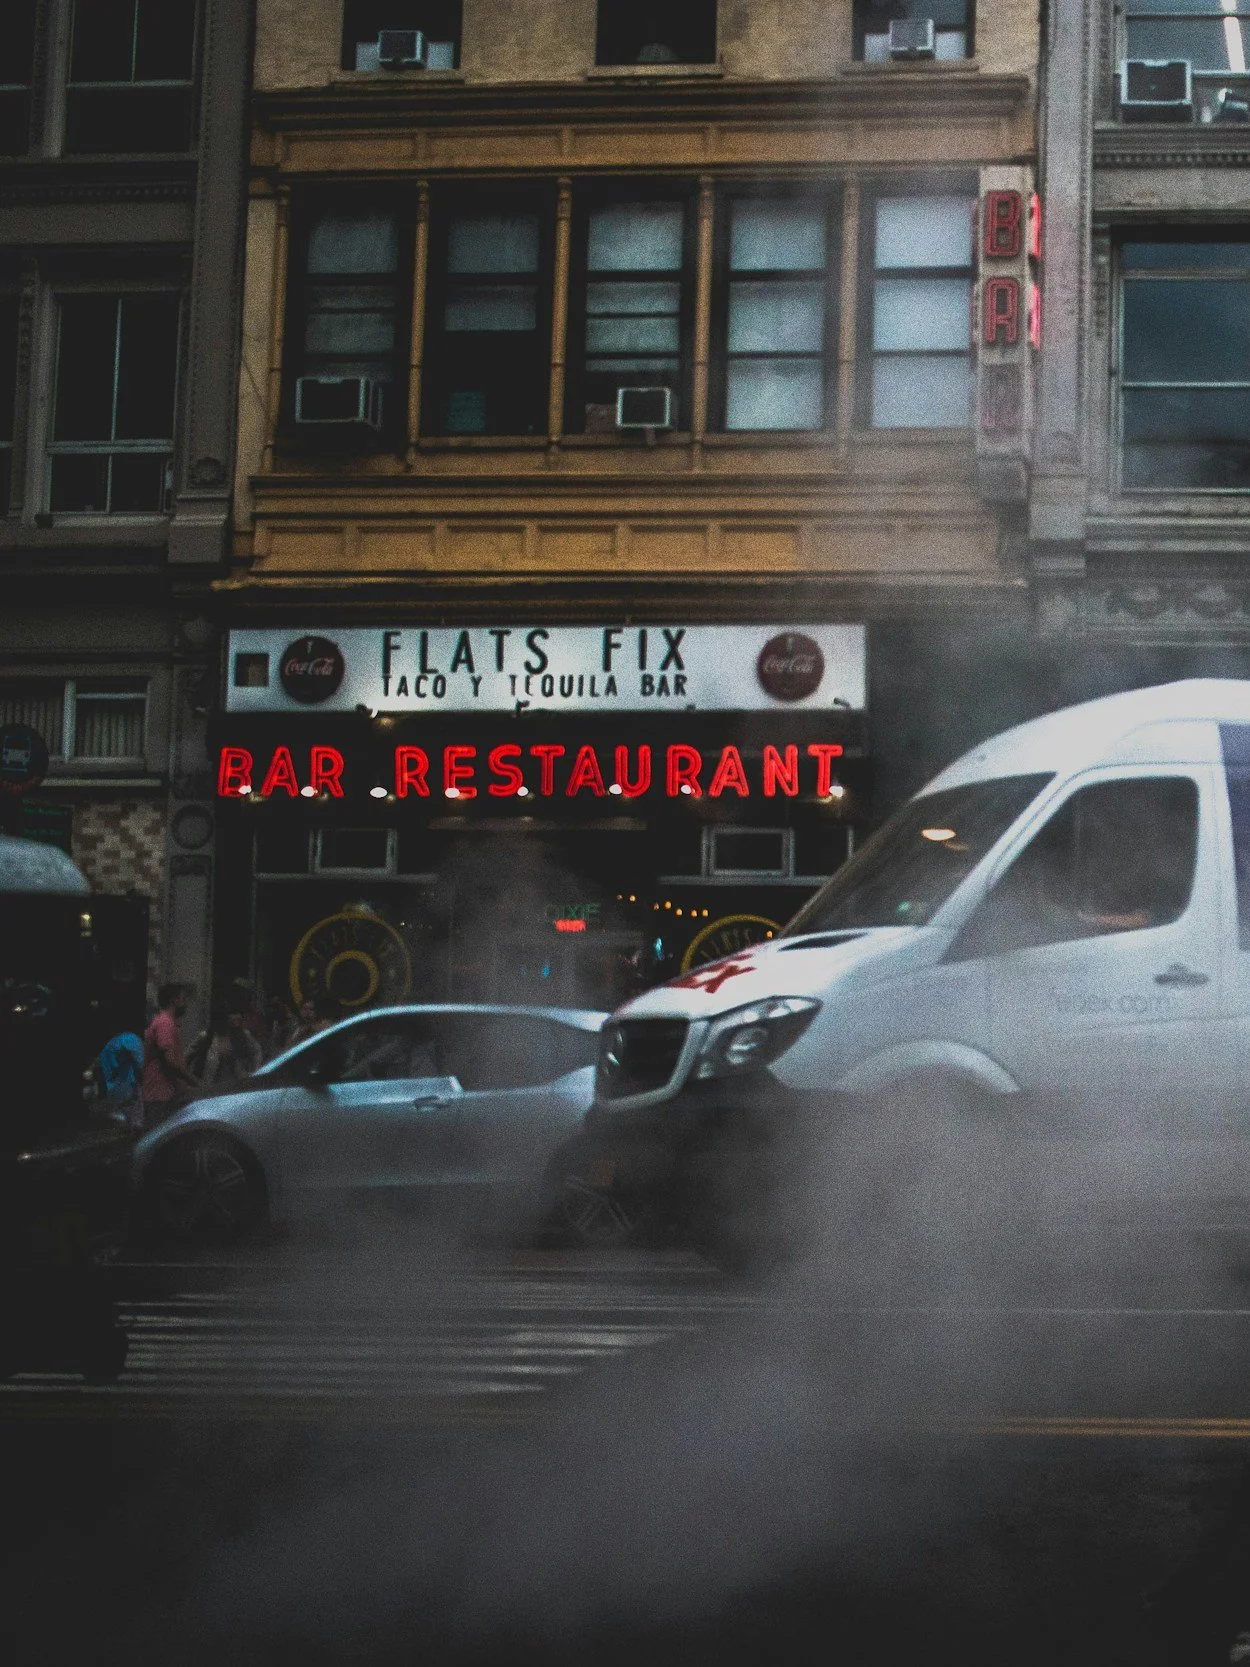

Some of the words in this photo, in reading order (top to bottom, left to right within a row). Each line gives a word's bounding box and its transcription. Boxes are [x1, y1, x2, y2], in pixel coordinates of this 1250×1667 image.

[381, 630, 549, 675] FLATS
[601, 628, 686, 673] FIX
[382, 674, 447, 698] TACO
[470, 675, 483, 697] Y
[640, 673, 688, 697] BAR
[217, 746, 345, 798] BAR
[394, 744, 843, 798] RESTAURANT
